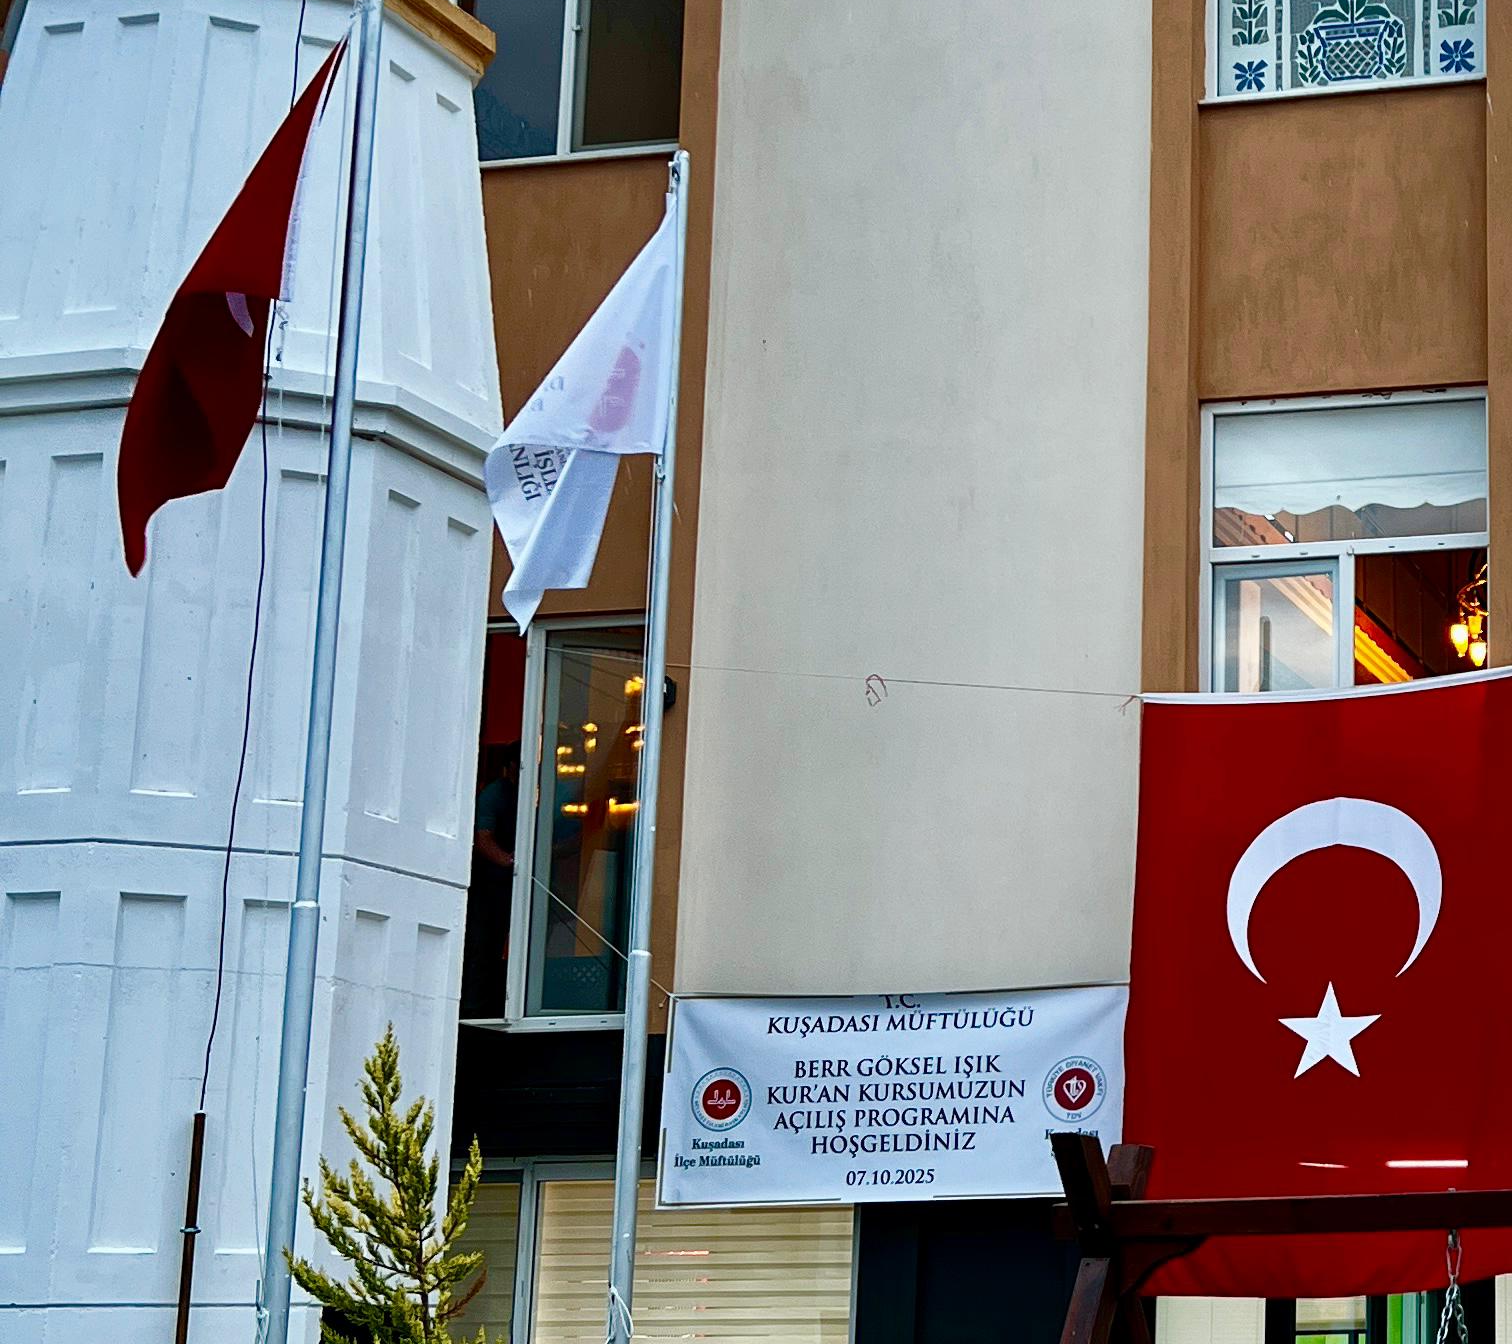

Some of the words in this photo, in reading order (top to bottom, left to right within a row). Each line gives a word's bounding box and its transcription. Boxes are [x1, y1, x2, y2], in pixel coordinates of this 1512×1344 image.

[878, 994, 921, 1009] T.C.
[767, 1014, 880, 1039] KUŞADASI
[885, 1006, 1034, 1033] MÜFTÜLÜĞÜ
[794, 1059, 850, 1080] BERR
[856, 1054, 947, 1077] GÖKSEL
[954, 1054, 1002, 1079] IŞIK
[766, 1085, 851, 1105] KUR'AN
[858, 1079, 1027, 1103] KURSUMUZUN
[773, 1109, 847, 1133] AÇILIŞ
[854, 1105, 1016, 1129] PROGRAMINA
[691, 1137, 745, 1153] Kuşadası
[811, 1130, 977, 1159] HOŞGELDİNİZ
[674, 1153, 697, 1170] İlçe
[698, 1154, 761, 1169] Müftülüğü
[845, 1168, 935, 1187] 07.10.2025
